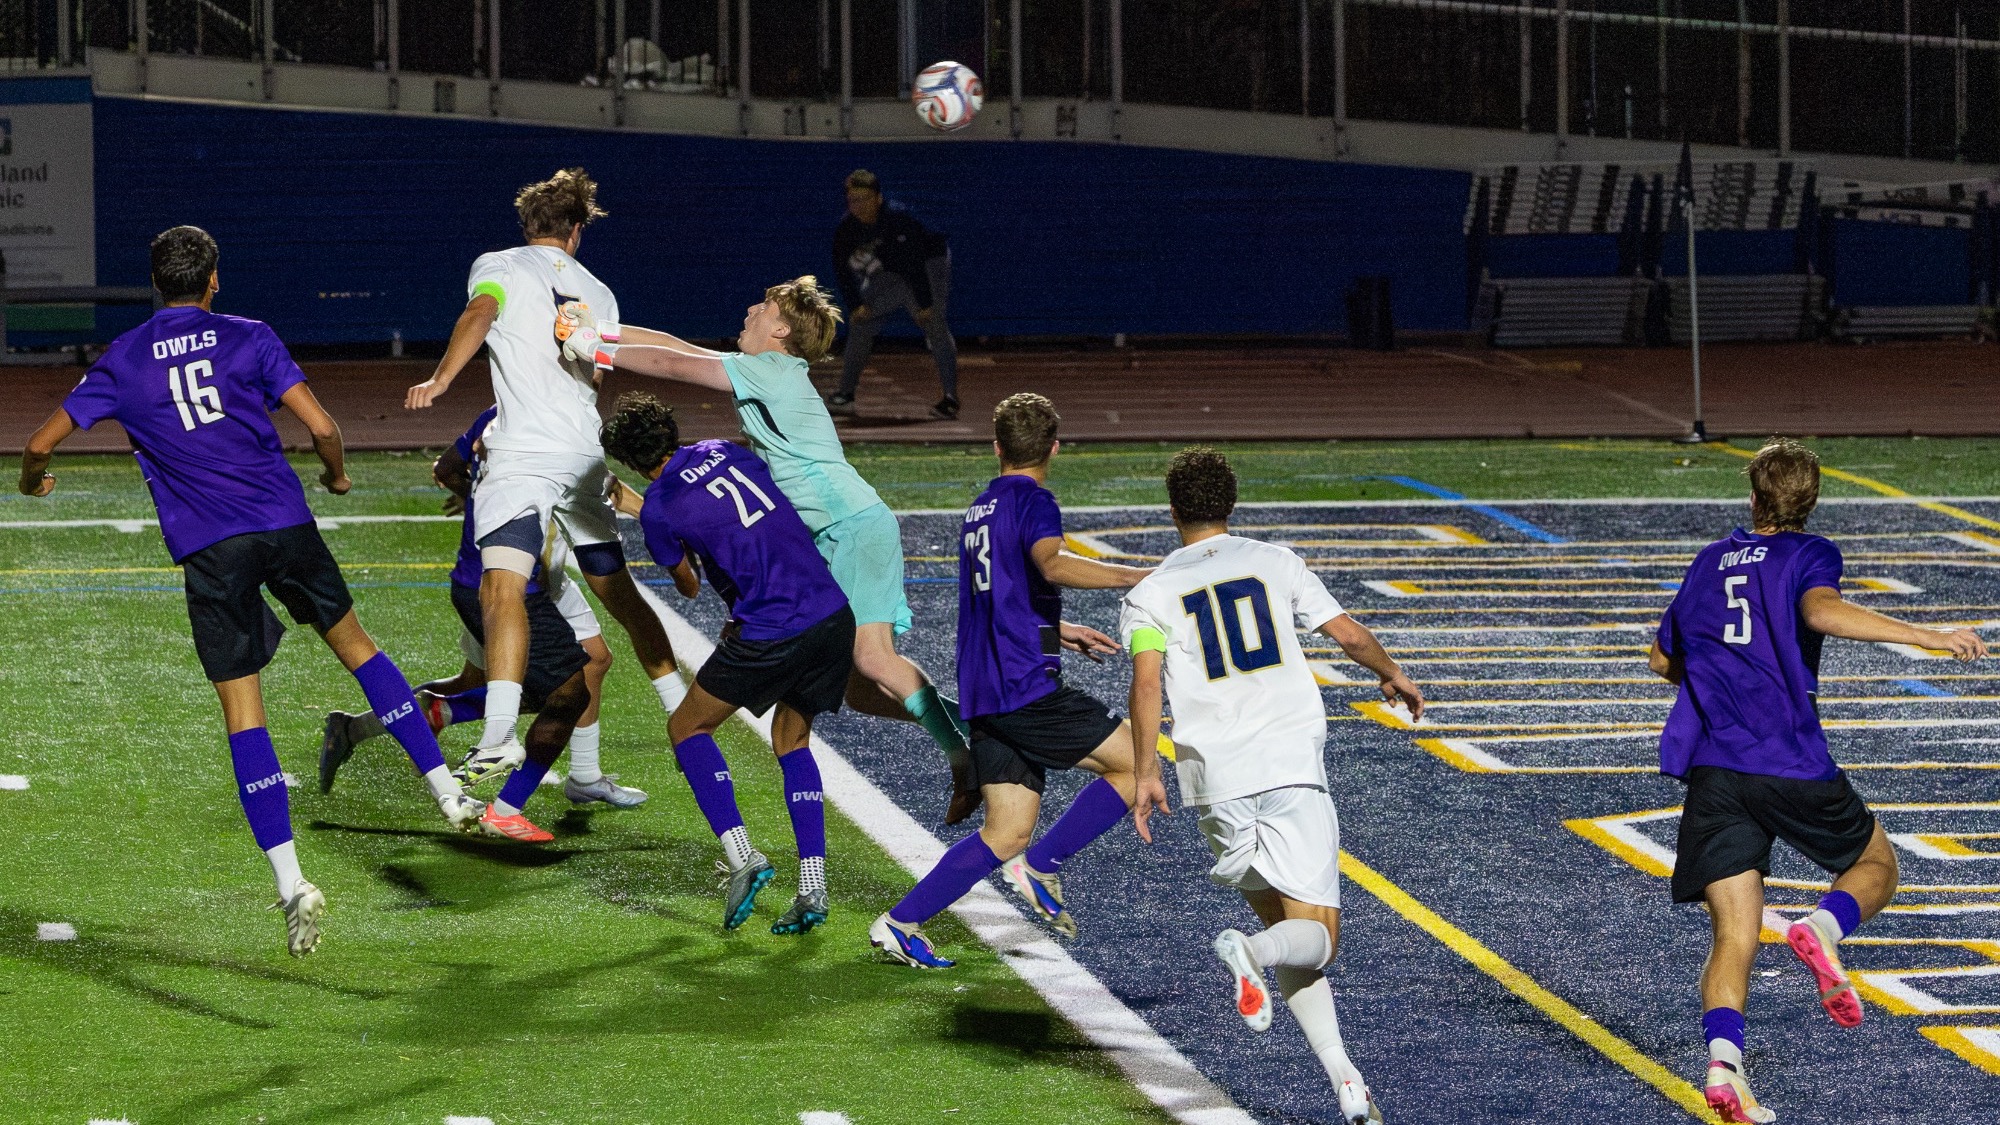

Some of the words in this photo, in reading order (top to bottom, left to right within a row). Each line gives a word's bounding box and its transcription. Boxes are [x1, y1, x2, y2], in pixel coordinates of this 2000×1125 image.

[152, 329, 218, 360] OWLS
[168, 359, 226, 432] 16
[679, 449, 727, 484] OWLS
[705, 465, 777, 529] 21
[965, 498, 998, 523] OWLS
[1718, 546, 1769, 571] OWLS
[1178, 574, 1285, 683] 10
[1723, 575, 1752, 645] 5
